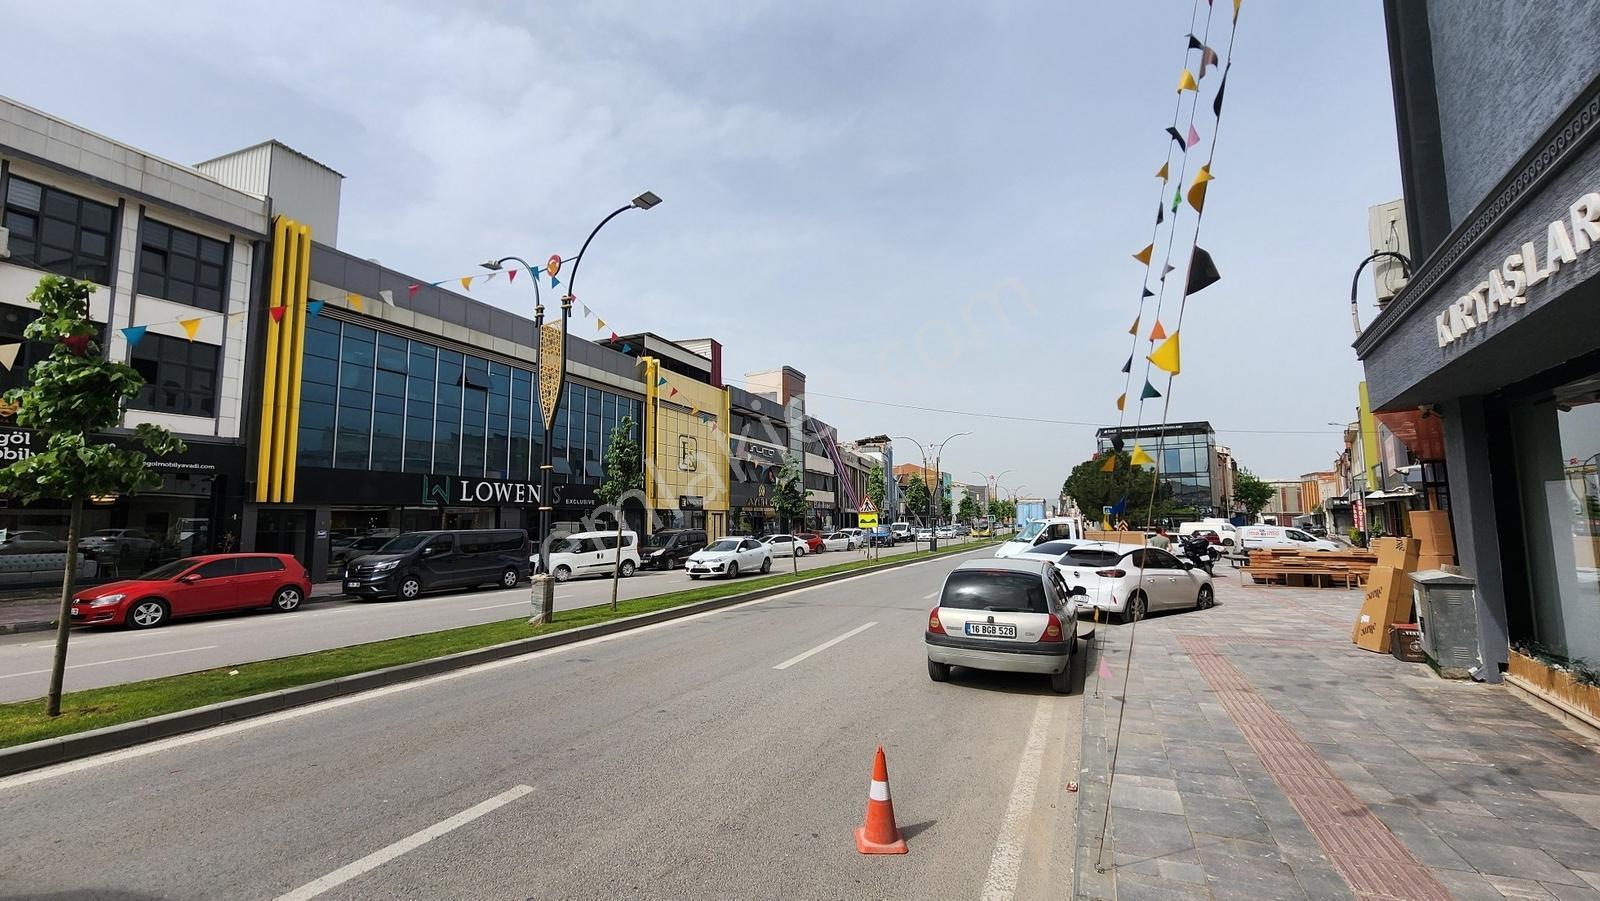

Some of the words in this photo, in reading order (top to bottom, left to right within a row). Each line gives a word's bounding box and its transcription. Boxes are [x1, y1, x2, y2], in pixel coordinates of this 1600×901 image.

[971, 625, 980, 633] 16
[981, 626, 997, 634] BGB
[998, 627, 1014, 635] 528
